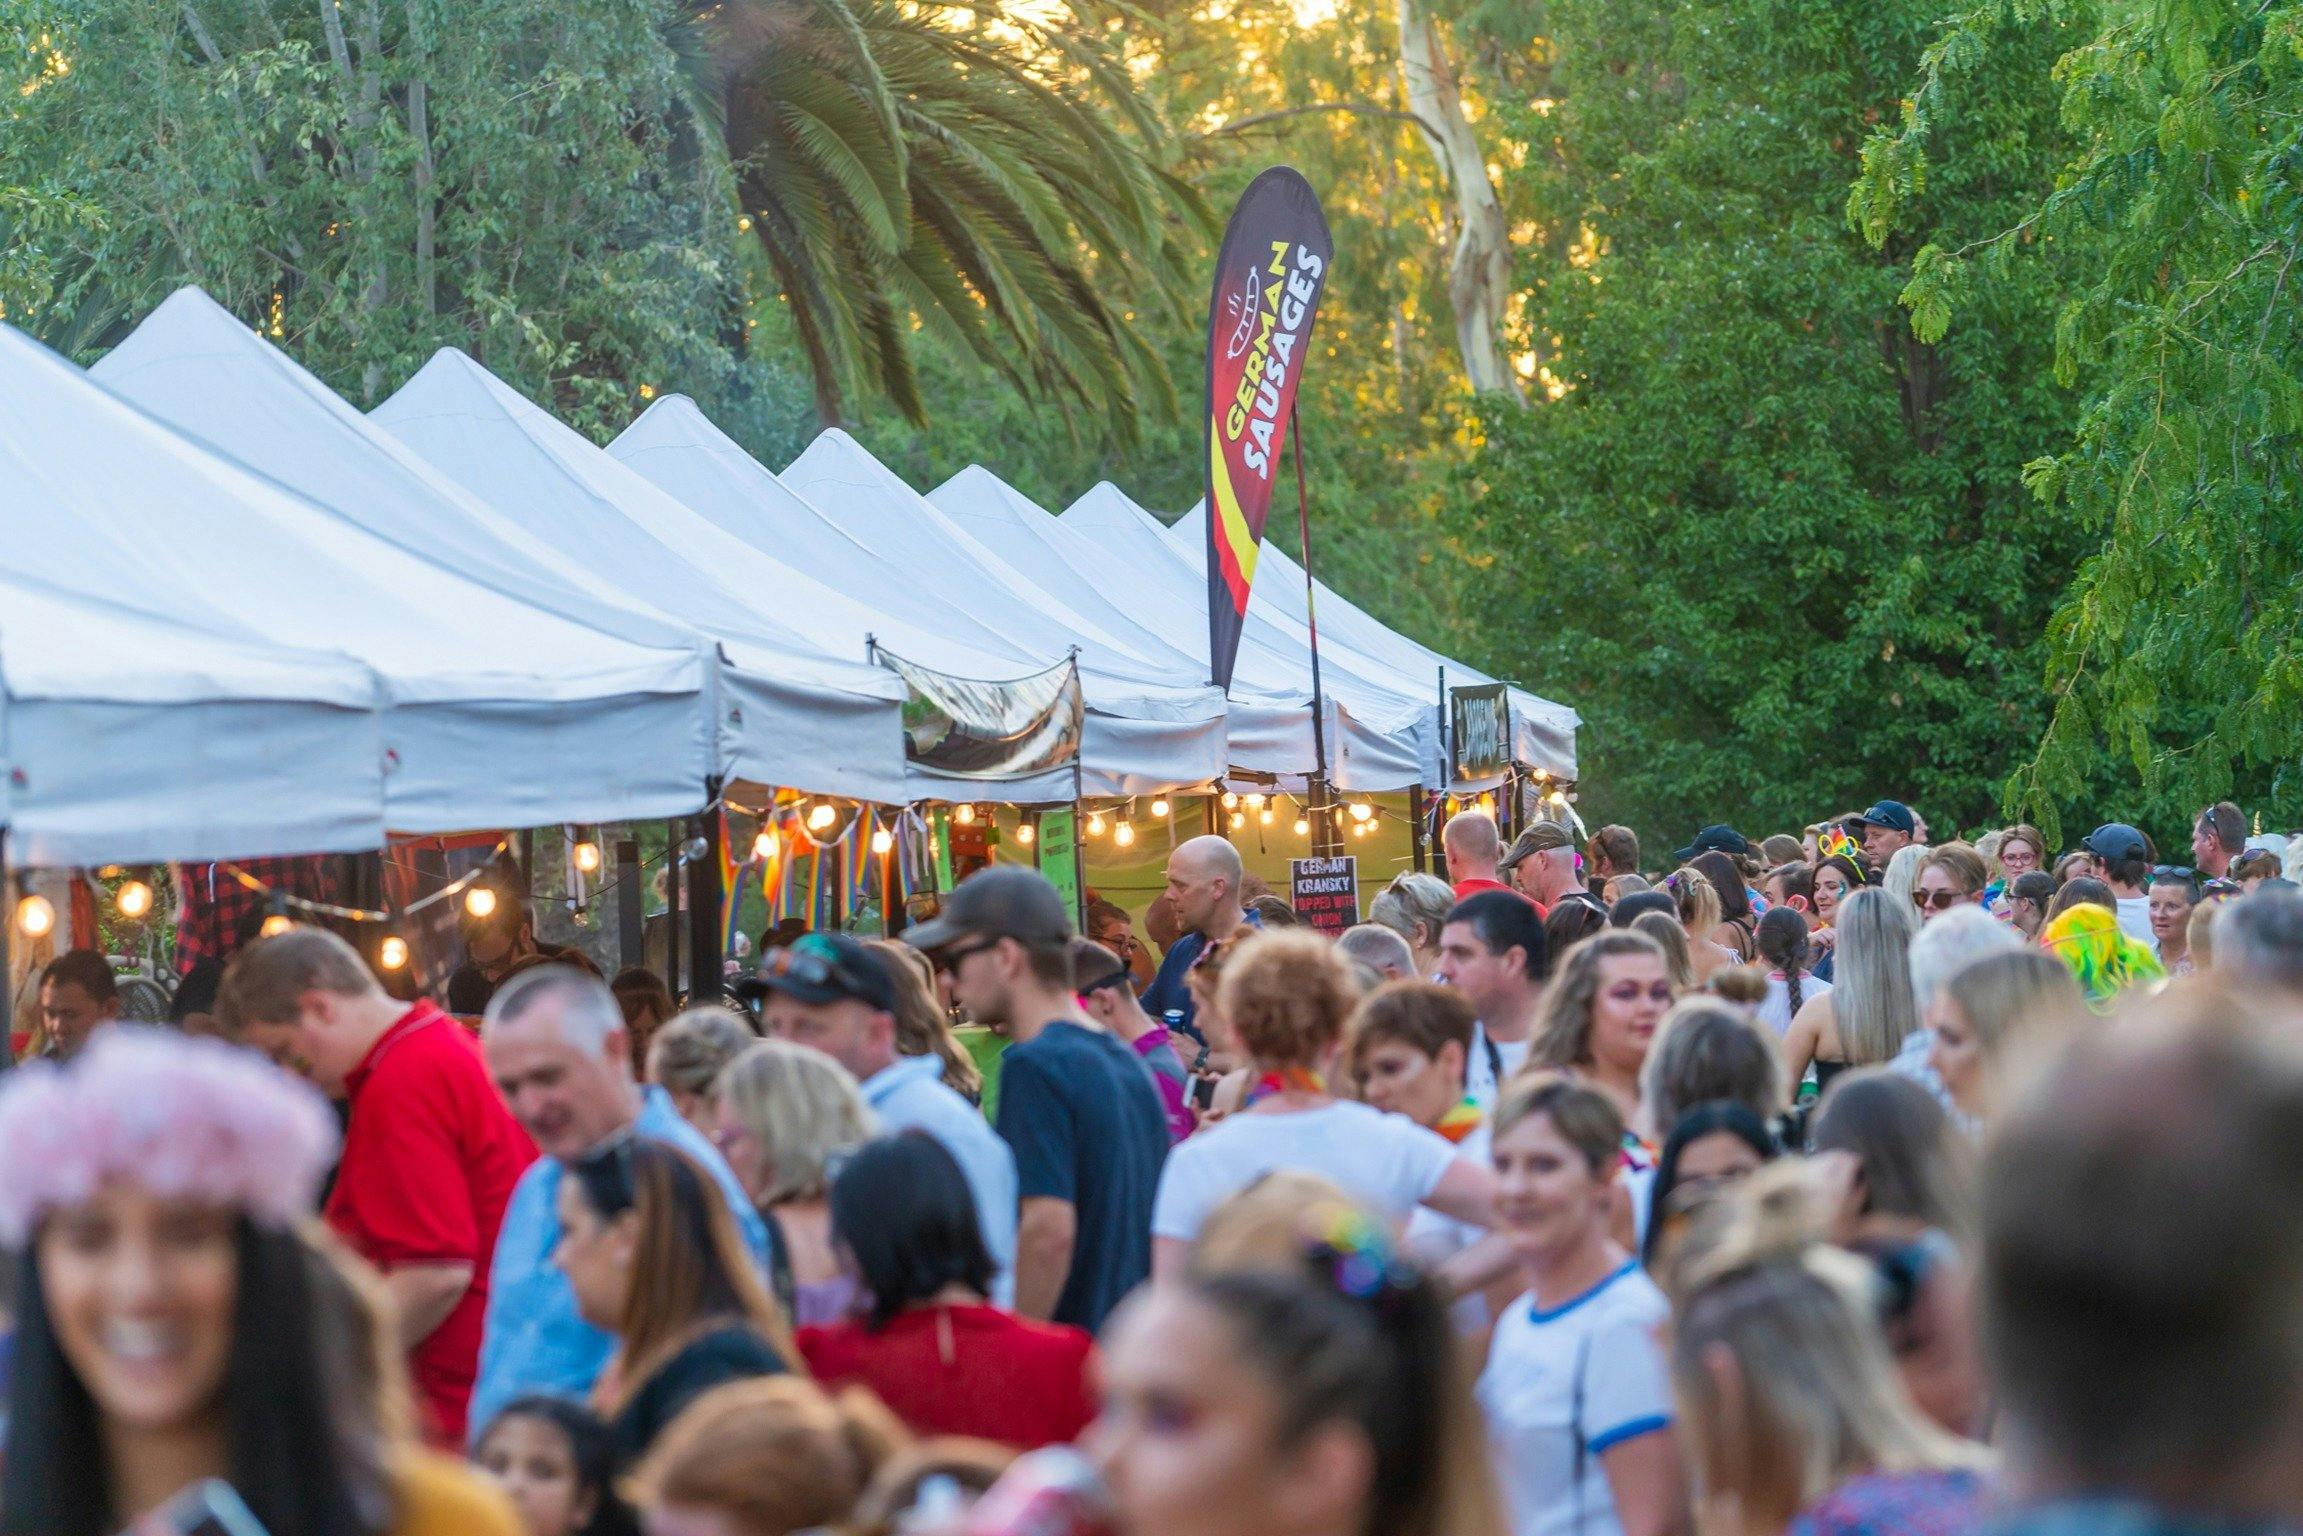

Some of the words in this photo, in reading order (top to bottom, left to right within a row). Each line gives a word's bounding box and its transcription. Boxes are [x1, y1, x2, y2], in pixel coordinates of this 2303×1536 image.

[1226, 240, 1290, 441] GERMAN
[1243, 244, 1323, 480] SAUSAGES
[1297, 877, 1349, 893] KRANSKY
[1300, 857, 1346, 874] GERMAN
